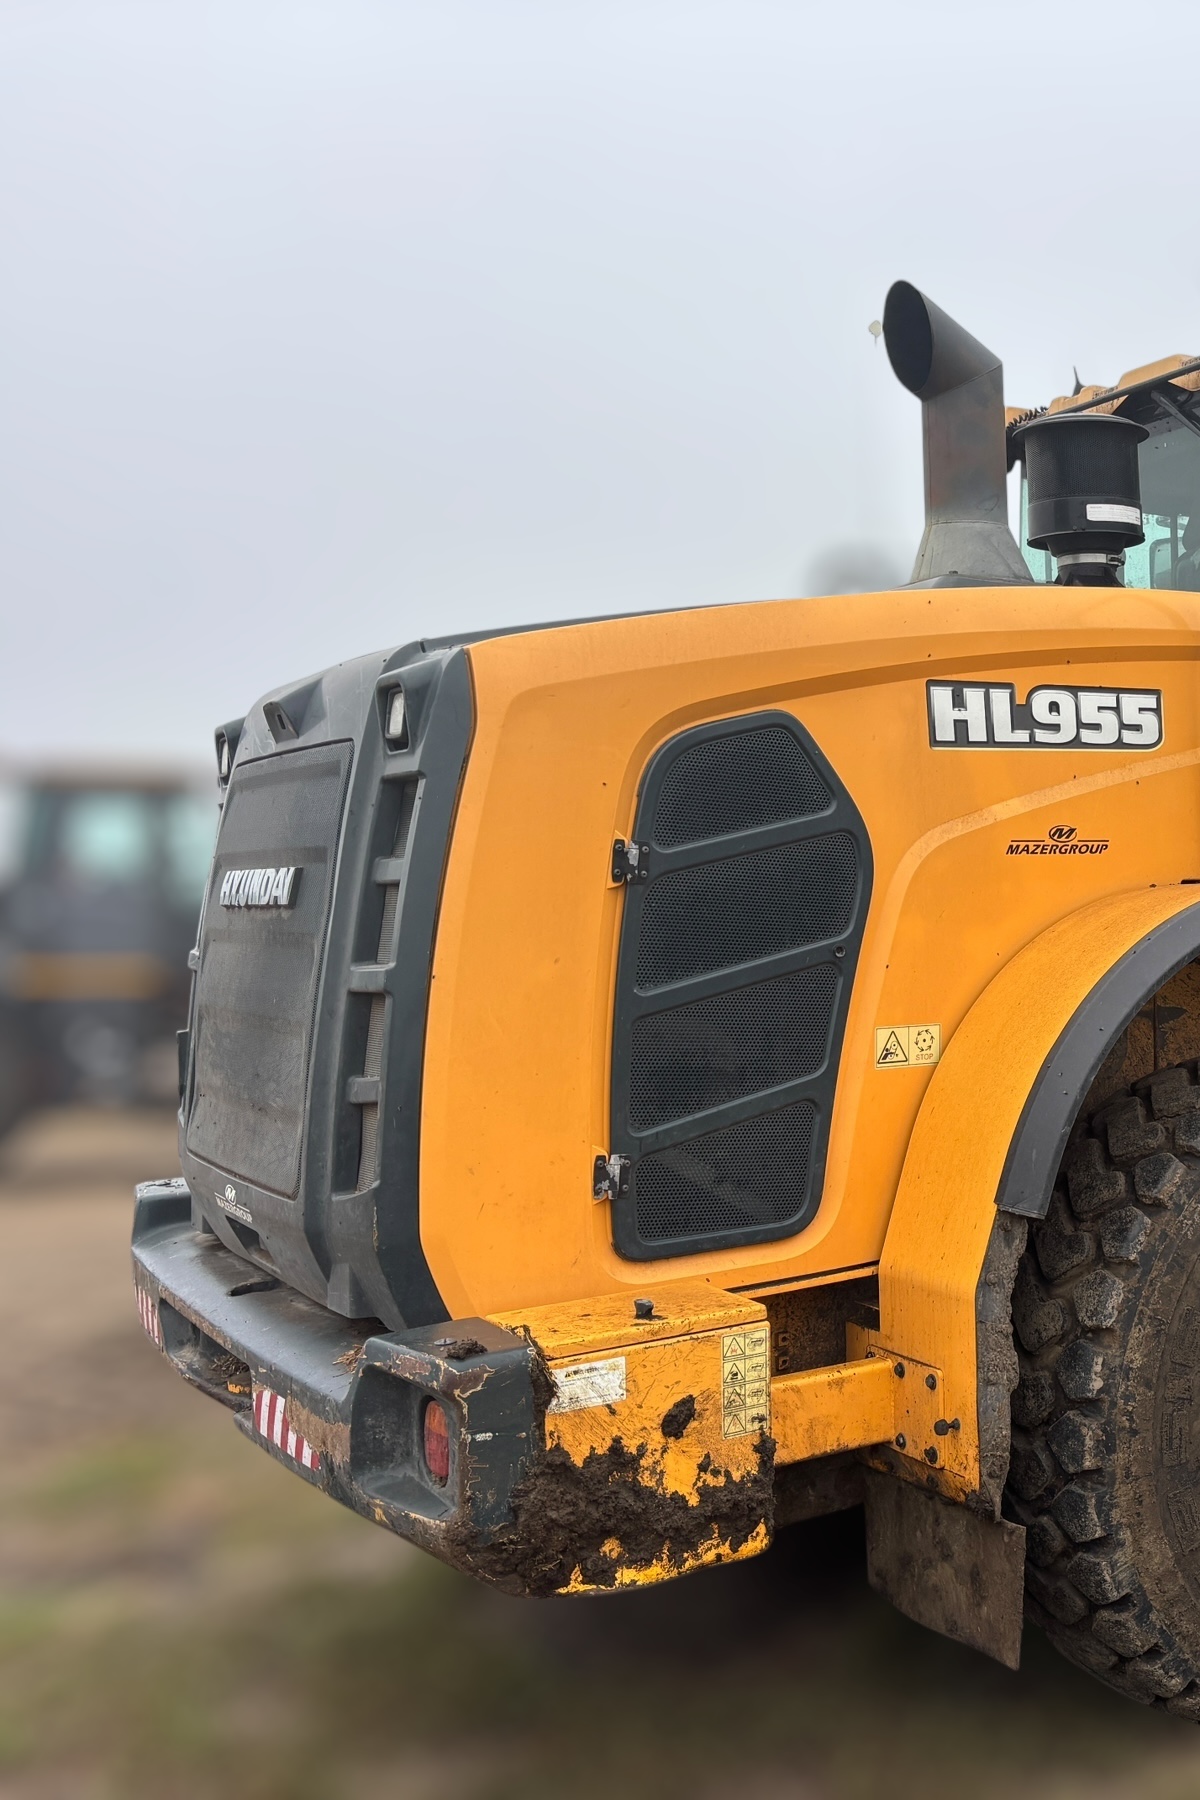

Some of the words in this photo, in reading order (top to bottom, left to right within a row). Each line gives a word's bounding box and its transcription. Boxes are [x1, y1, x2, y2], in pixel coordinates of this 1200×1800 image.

[930, 687, 1160, 745] HL955
[1006, 844, 1109, 855] MAZERGROUP
[219, 867, 297, 907] HYUNDAI
[915, 1052, 934, 1061] STOP
